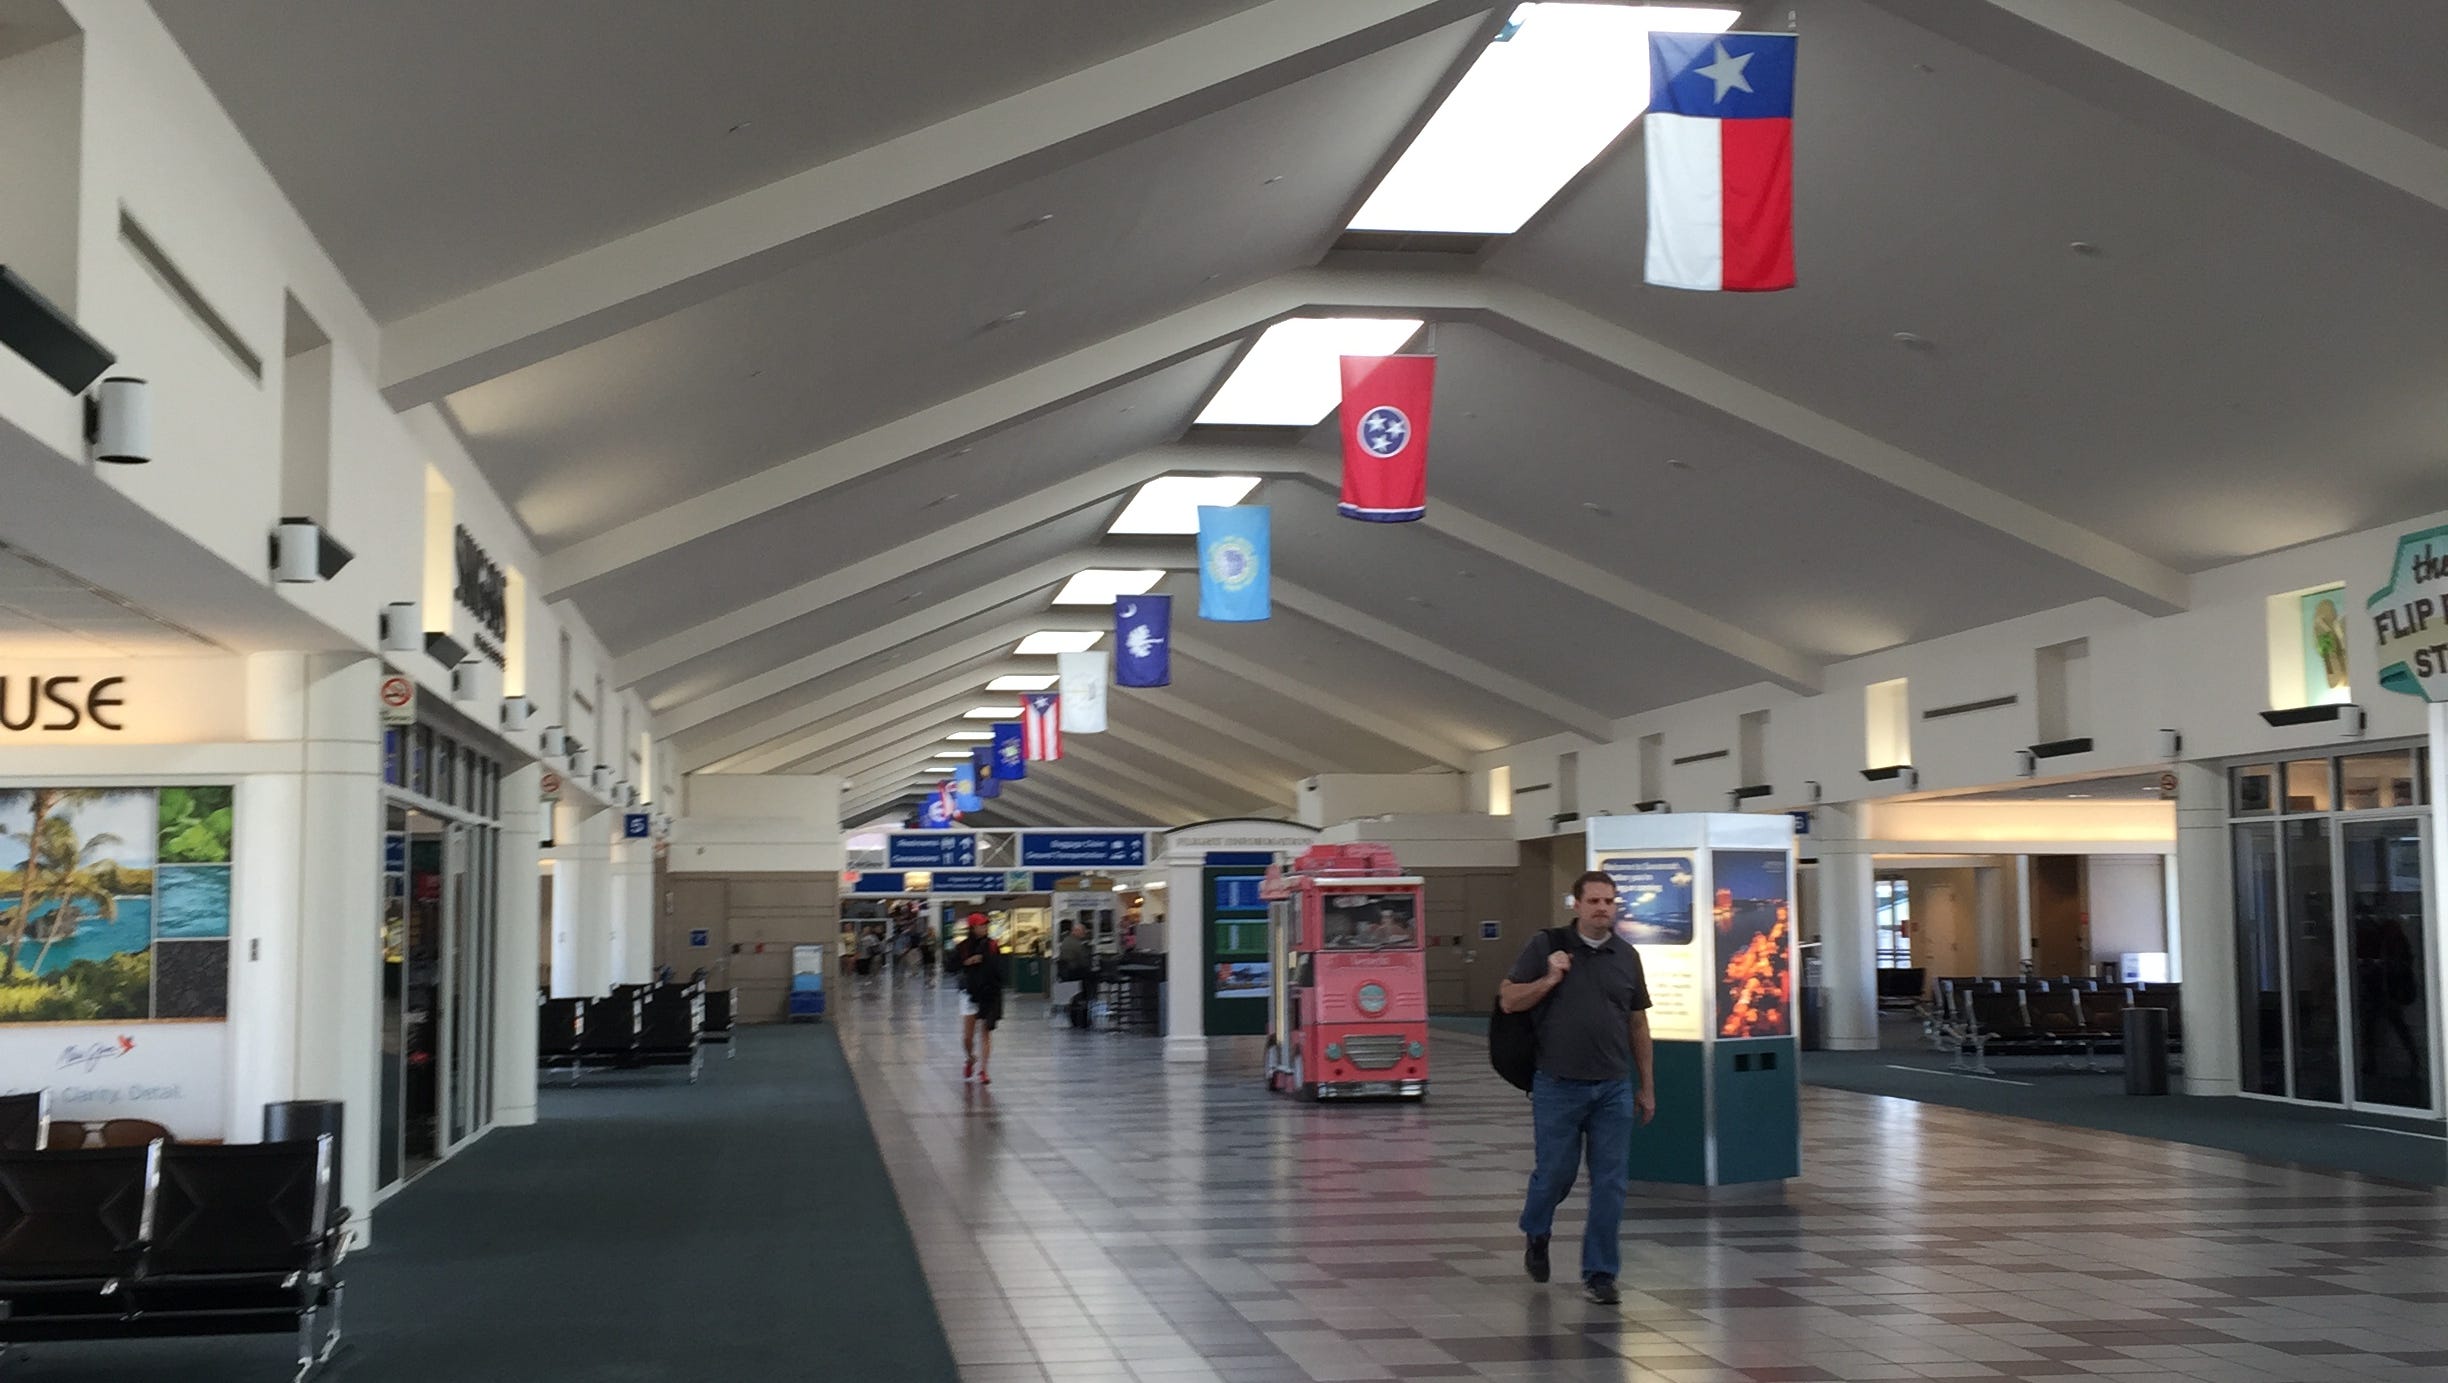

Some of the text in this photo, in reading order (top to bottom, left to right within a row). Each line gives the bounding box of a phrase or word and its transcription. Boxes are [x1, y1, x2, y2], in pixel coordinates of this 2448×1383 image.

[2374, 598, 2434, 646] FLIP
[0, 675, 124, 731] USE
[630, 817, 645, 834] 5
